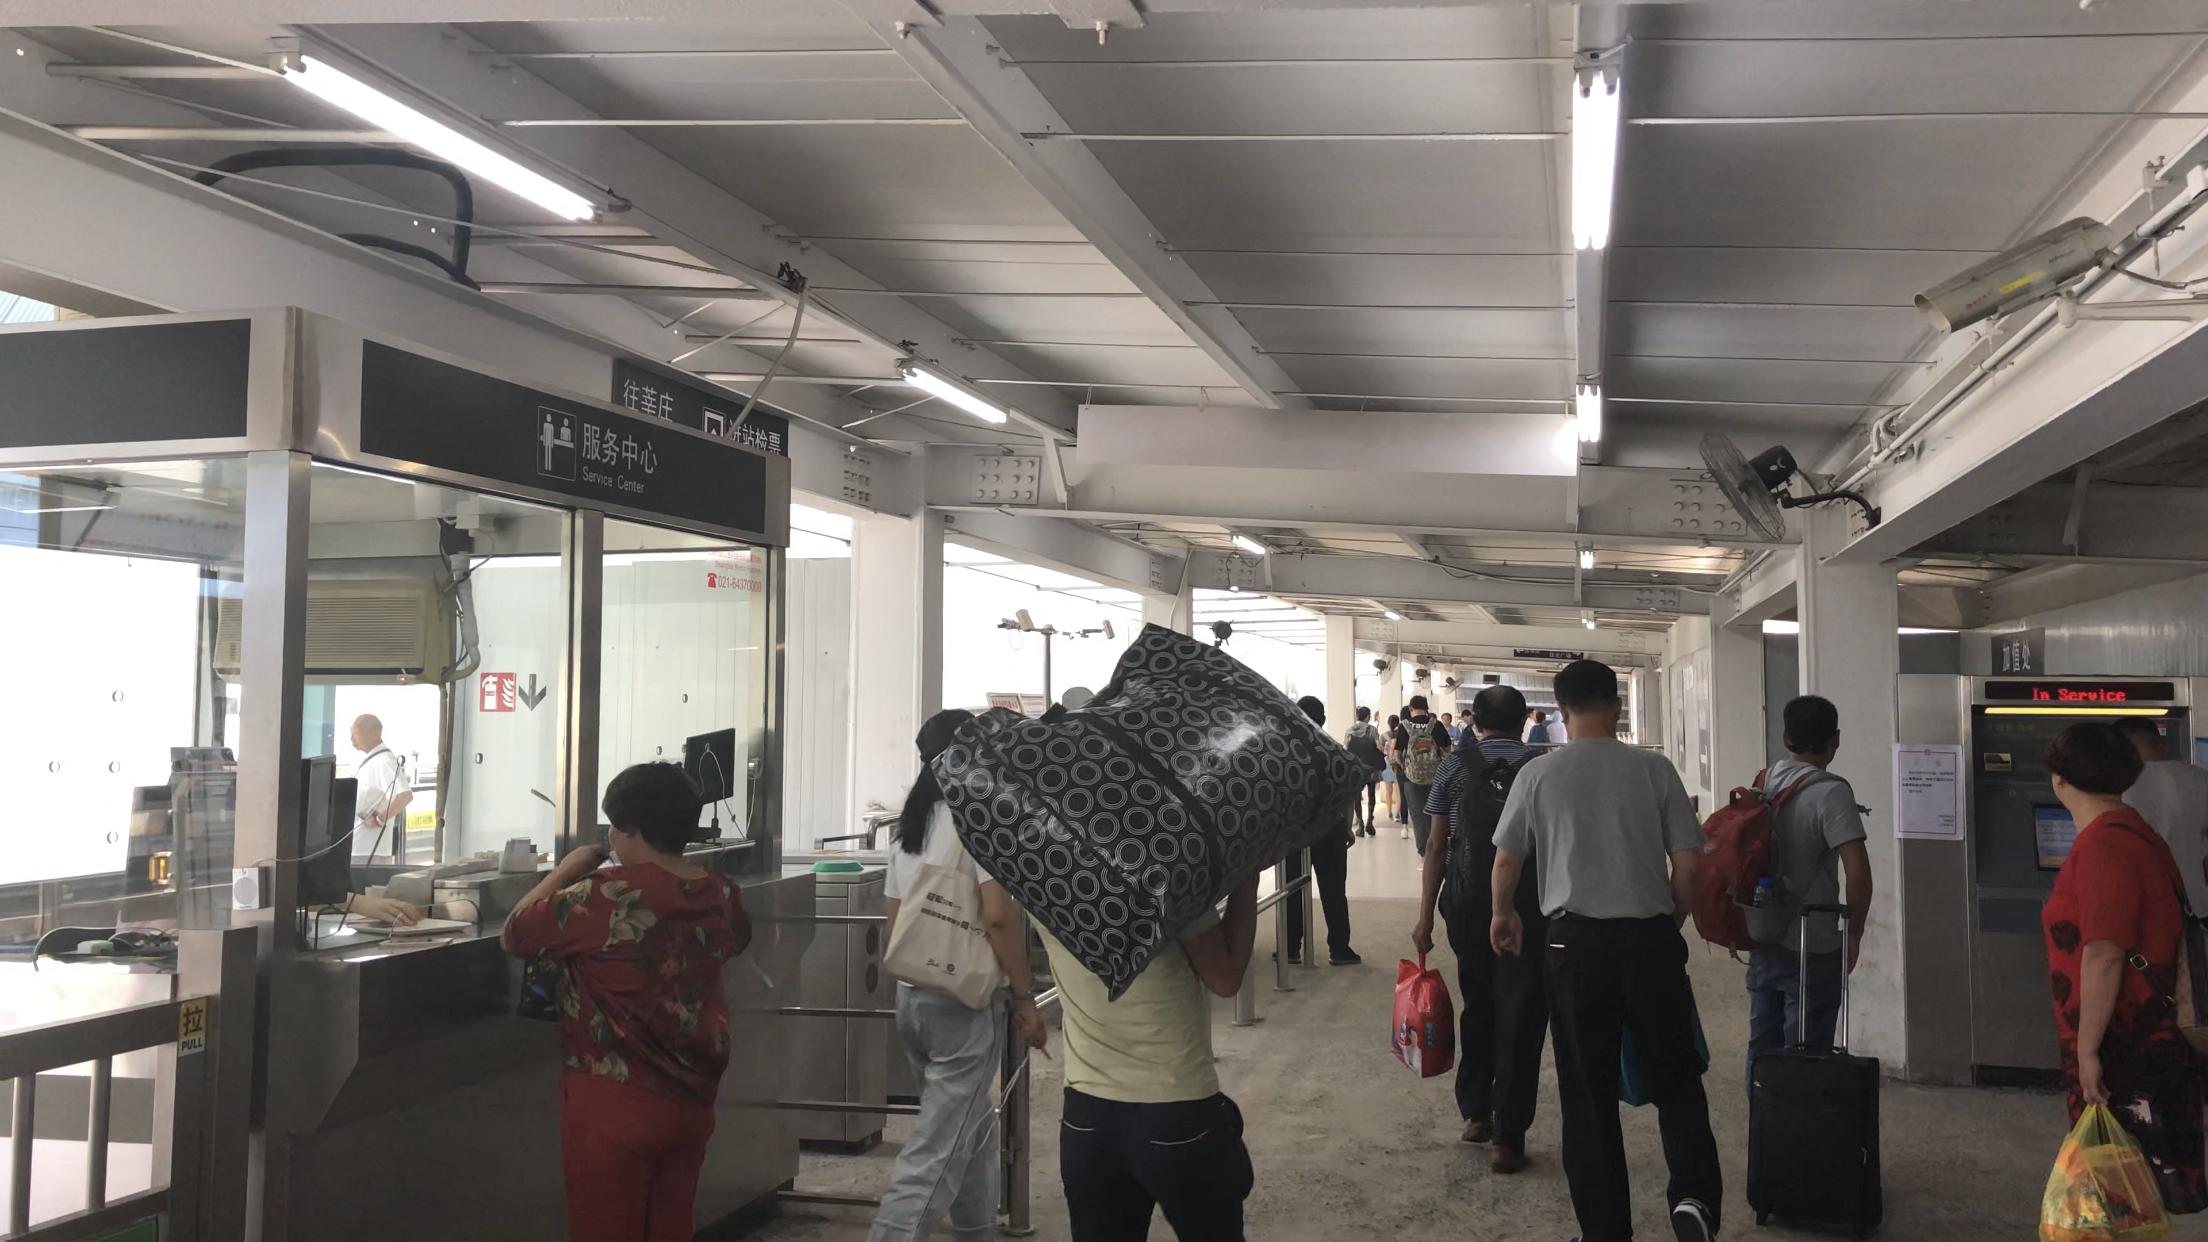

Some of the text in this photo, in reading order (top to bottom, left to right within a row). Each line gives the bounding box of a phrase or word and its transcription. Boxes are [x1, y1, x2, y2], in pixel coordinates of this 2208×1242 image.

[623, 378, 674, 423] 往莘庄
[582, 422, 658, 474] 服务中心
[582, 466, 645, 494] Service Center
[2032, 687, 2126, 702] In Service
[183, 1006, 203, 1036] 拉
[181, 1037, 203, 1051] PULL
